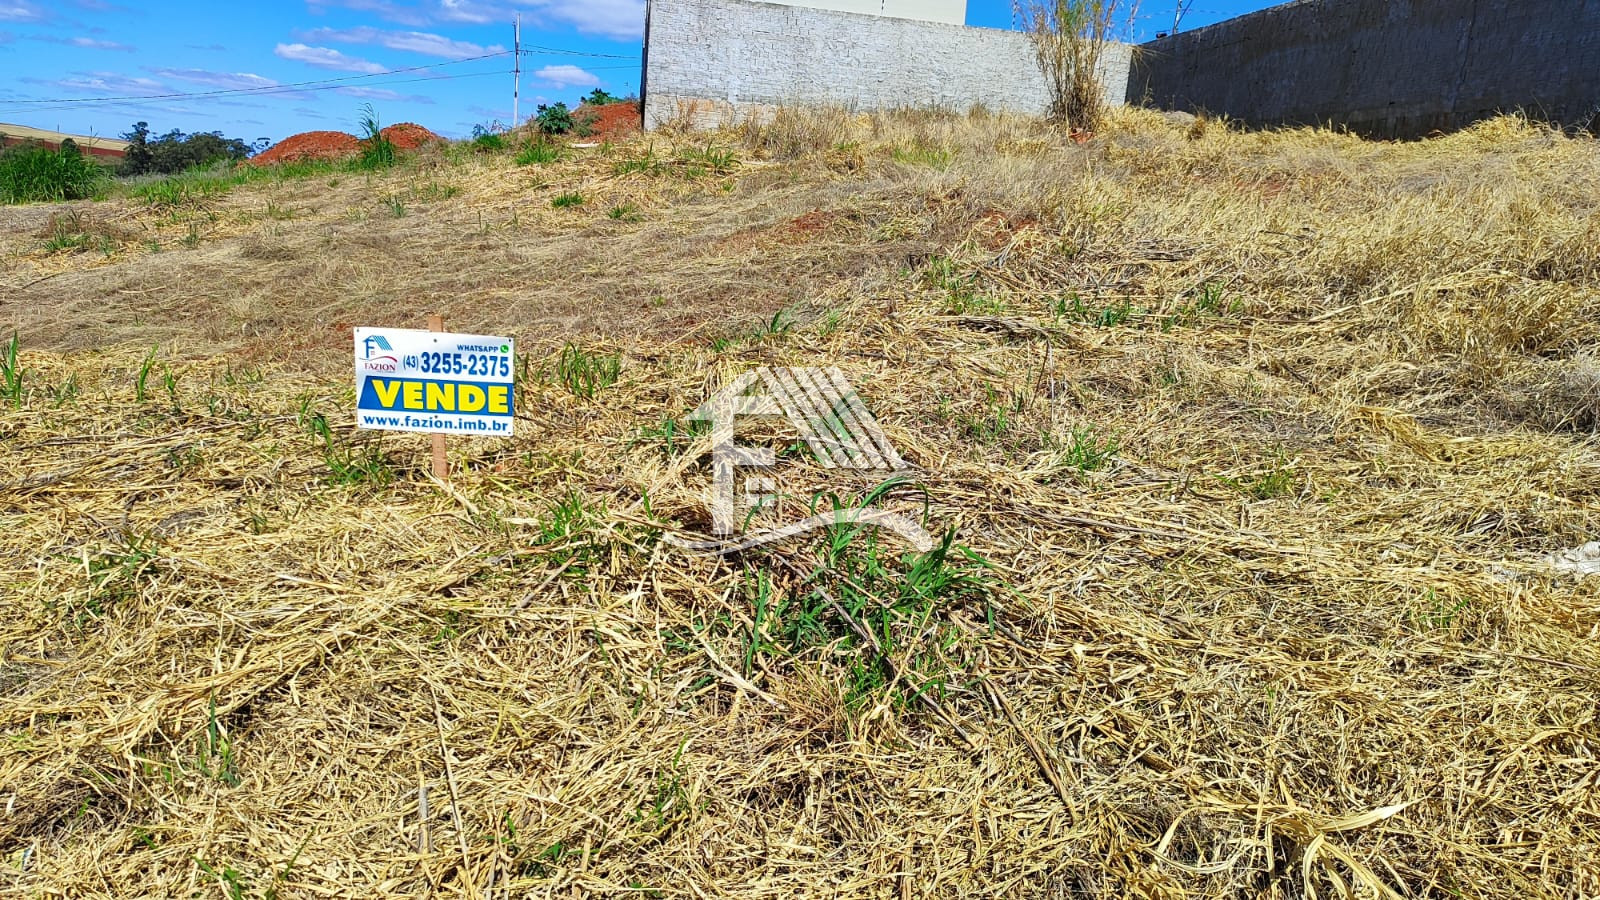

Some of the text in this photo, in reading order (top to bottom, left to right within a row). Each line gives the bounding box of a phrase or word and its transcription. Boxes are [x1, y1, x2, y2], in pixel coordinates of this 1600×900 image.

[457, 344, 498, 353] WHATSAPP
[364, 362, 396, 371] FAZION
[403, 352, 509, 377] (43) 3255-2375
[372, 379, 509, 414] VENDE
[363, 415, 509, 431] www.fazion.imb.br
